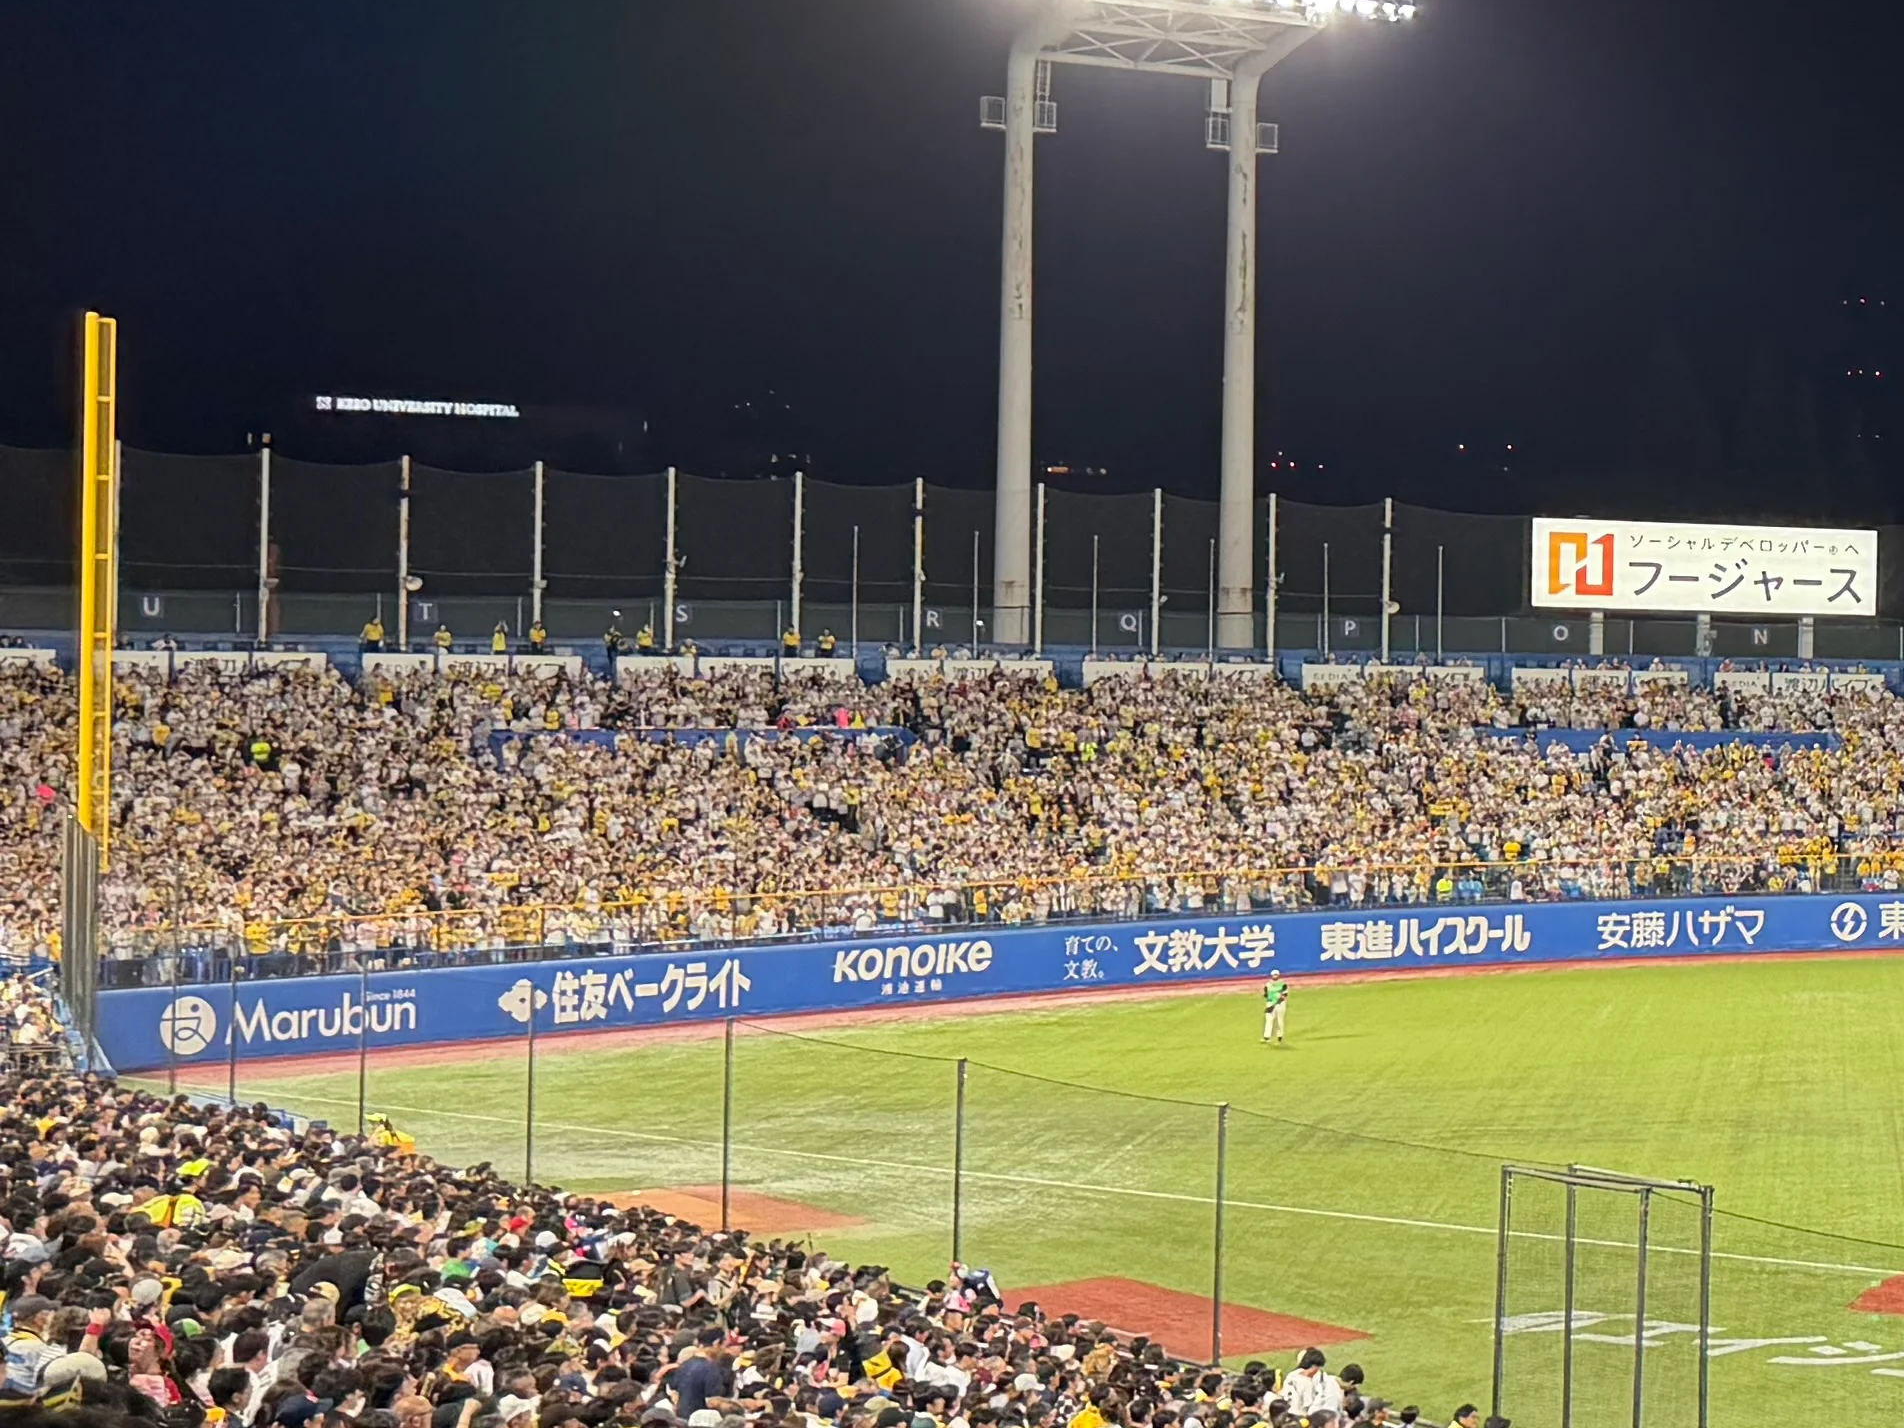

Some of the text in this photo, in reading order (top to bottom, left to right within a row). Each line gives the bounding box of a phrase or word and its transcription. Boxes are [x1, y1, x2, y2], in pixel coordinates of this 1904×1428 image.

[373, 399, 454, 415] UNIVERSITY
[454, 403, 520, 417] HOSPITAL
[1627, 557, 1864, 605] フージャース
[143, 597, 161, 616] U
[419, 603, 432, 620] T
[676, 604, 688, 622] S
[926, 610, 940, 628] R
[1120, 614, 1137, 632] Q
[1344, 620, 1356, 635] P
[1553, 626, 1568, 642] O
[1754, 630, 1768, 644] N
[1595, 902, 1766, 951] 安藤ハザマ
[1319, 913, 1532, 963] 東進ハイスクール
[1132, 923, 1277, 976] 文教大学
[552, 958, 752, 1025] 住友ベークライト
[225, 991, 417, 1046] Marubun
